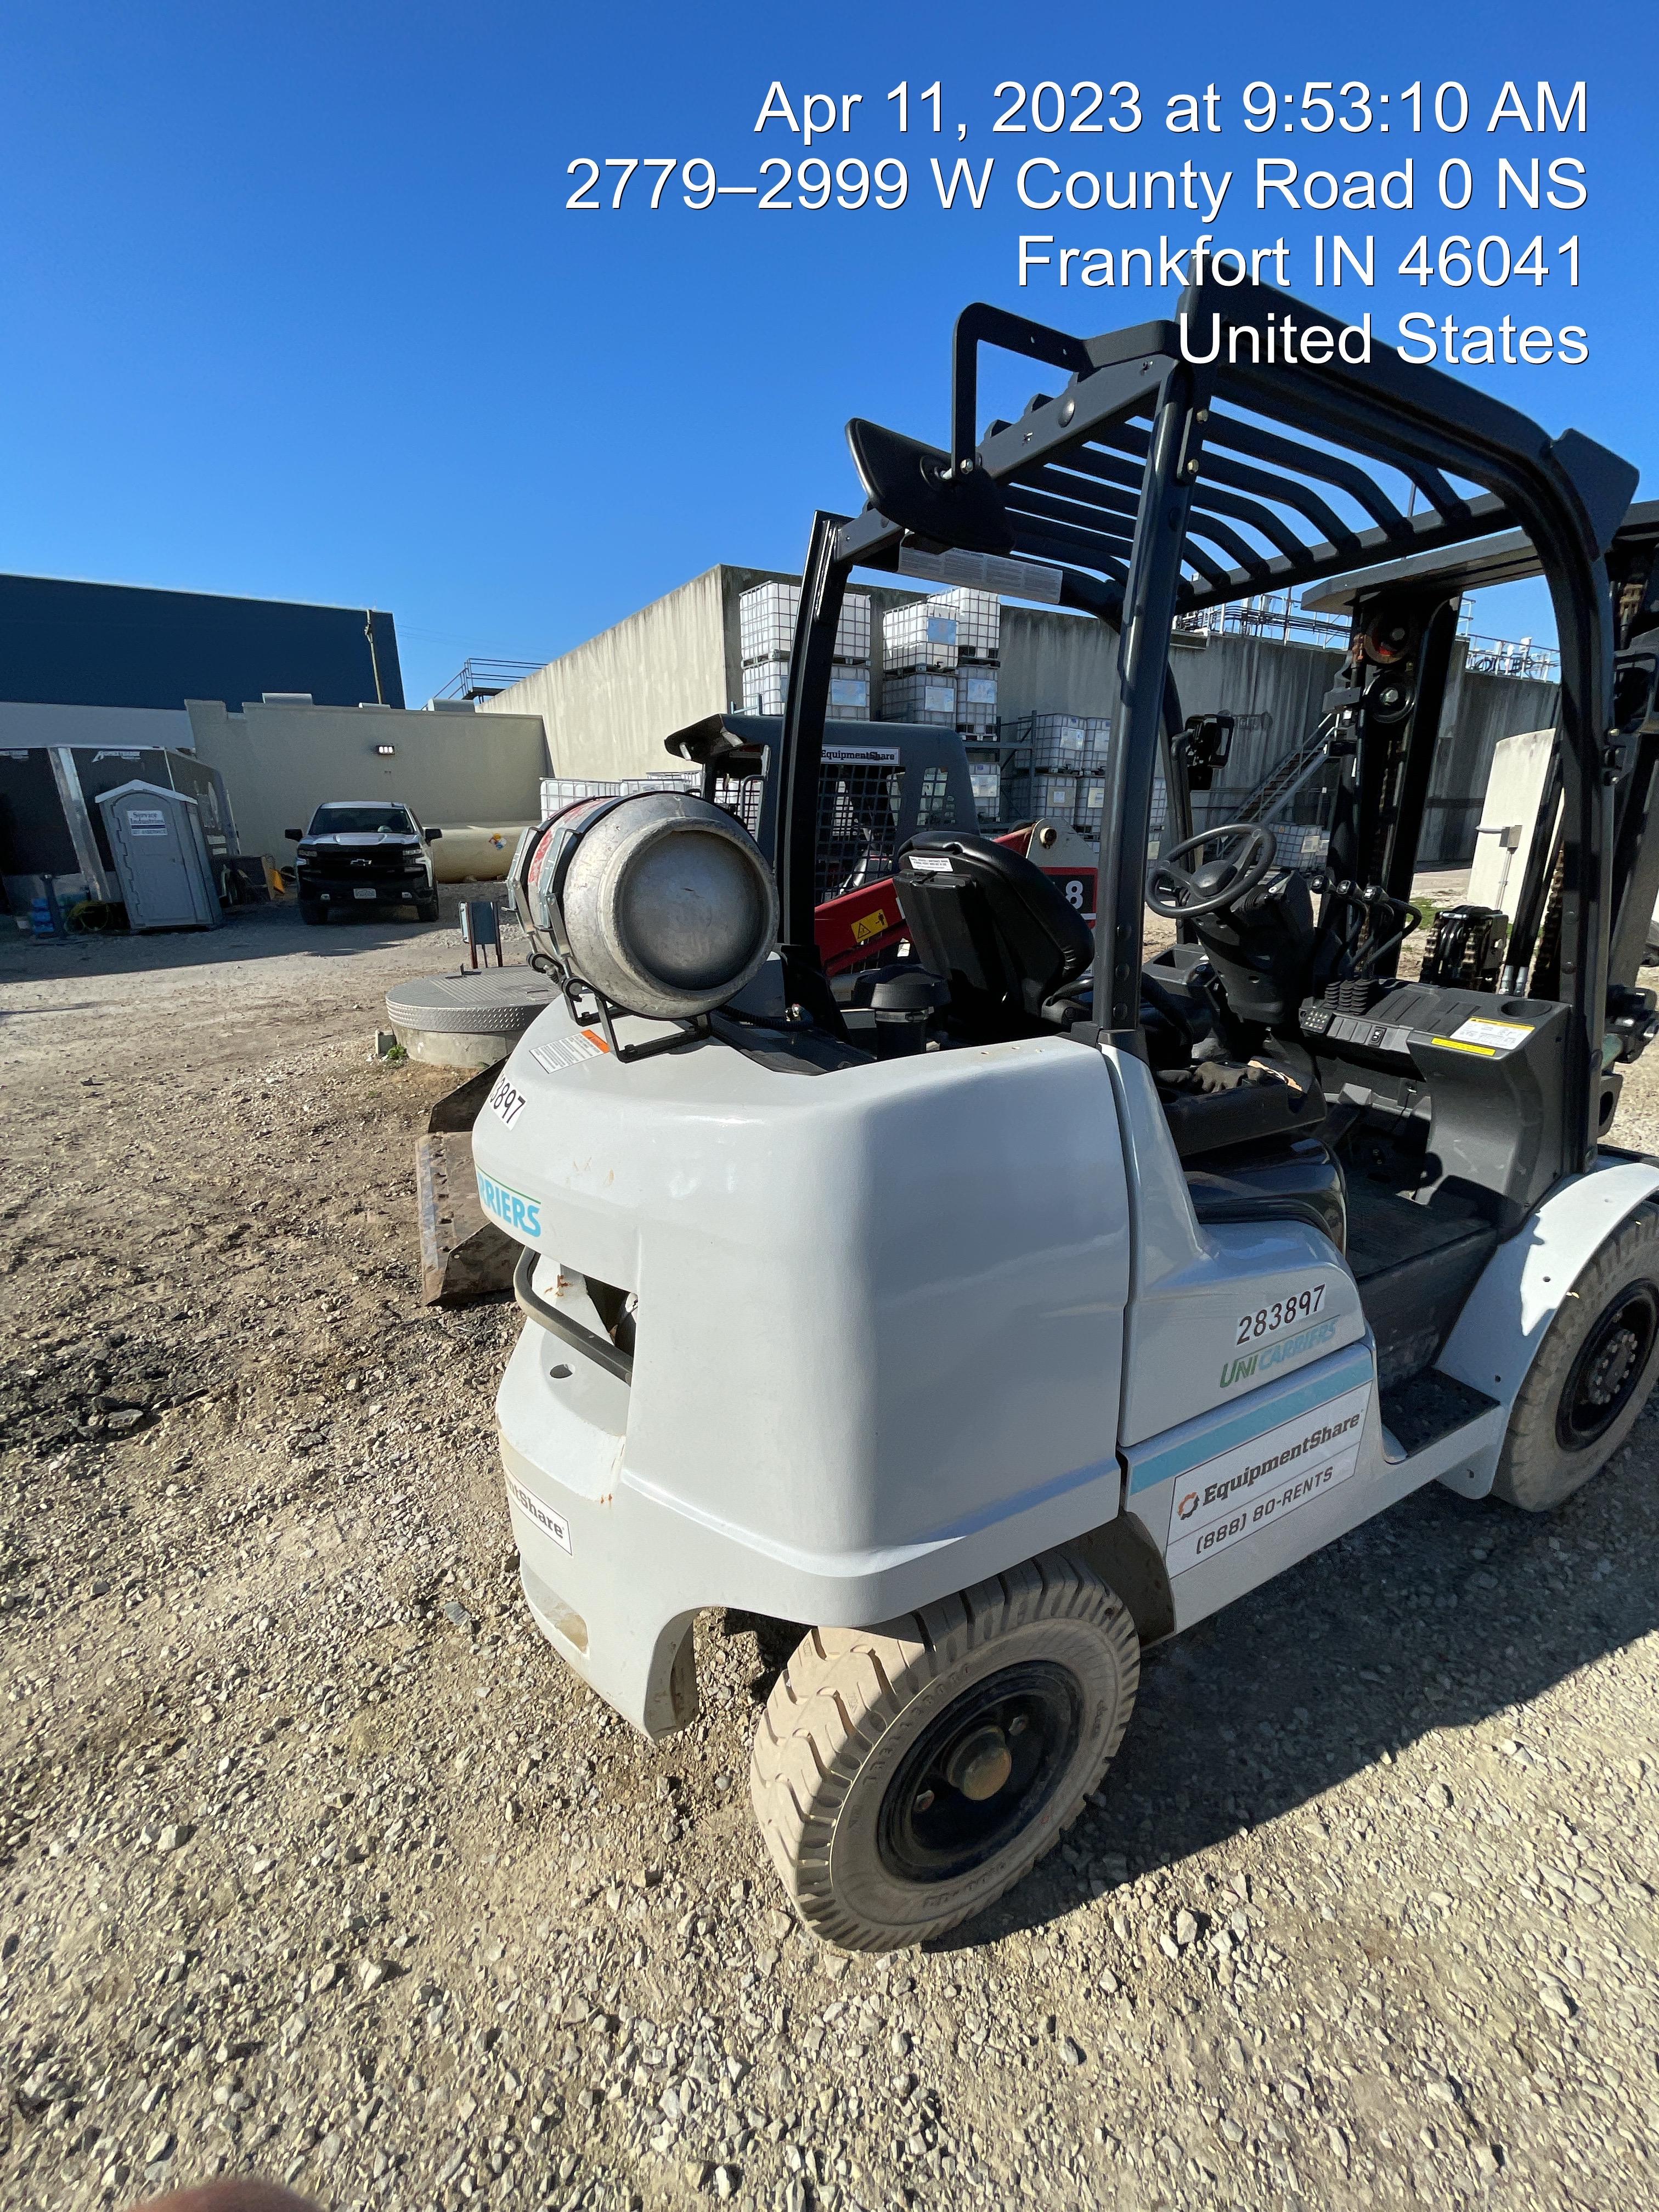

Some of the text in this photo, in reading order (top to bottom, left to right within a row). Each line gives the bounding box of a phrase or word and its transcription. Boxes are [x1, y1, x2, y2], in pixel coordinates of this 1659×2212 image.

[821, 749, 895, 761] EquipmentShare
[1065, 880, 1084, 910] 8
[1237, 1283, 1326, 1345] 283897
[1203, 1413, 1361, 1506] EquipmentShare
[1196, 1466, 1334, 1555] (888) 80-RENTS
